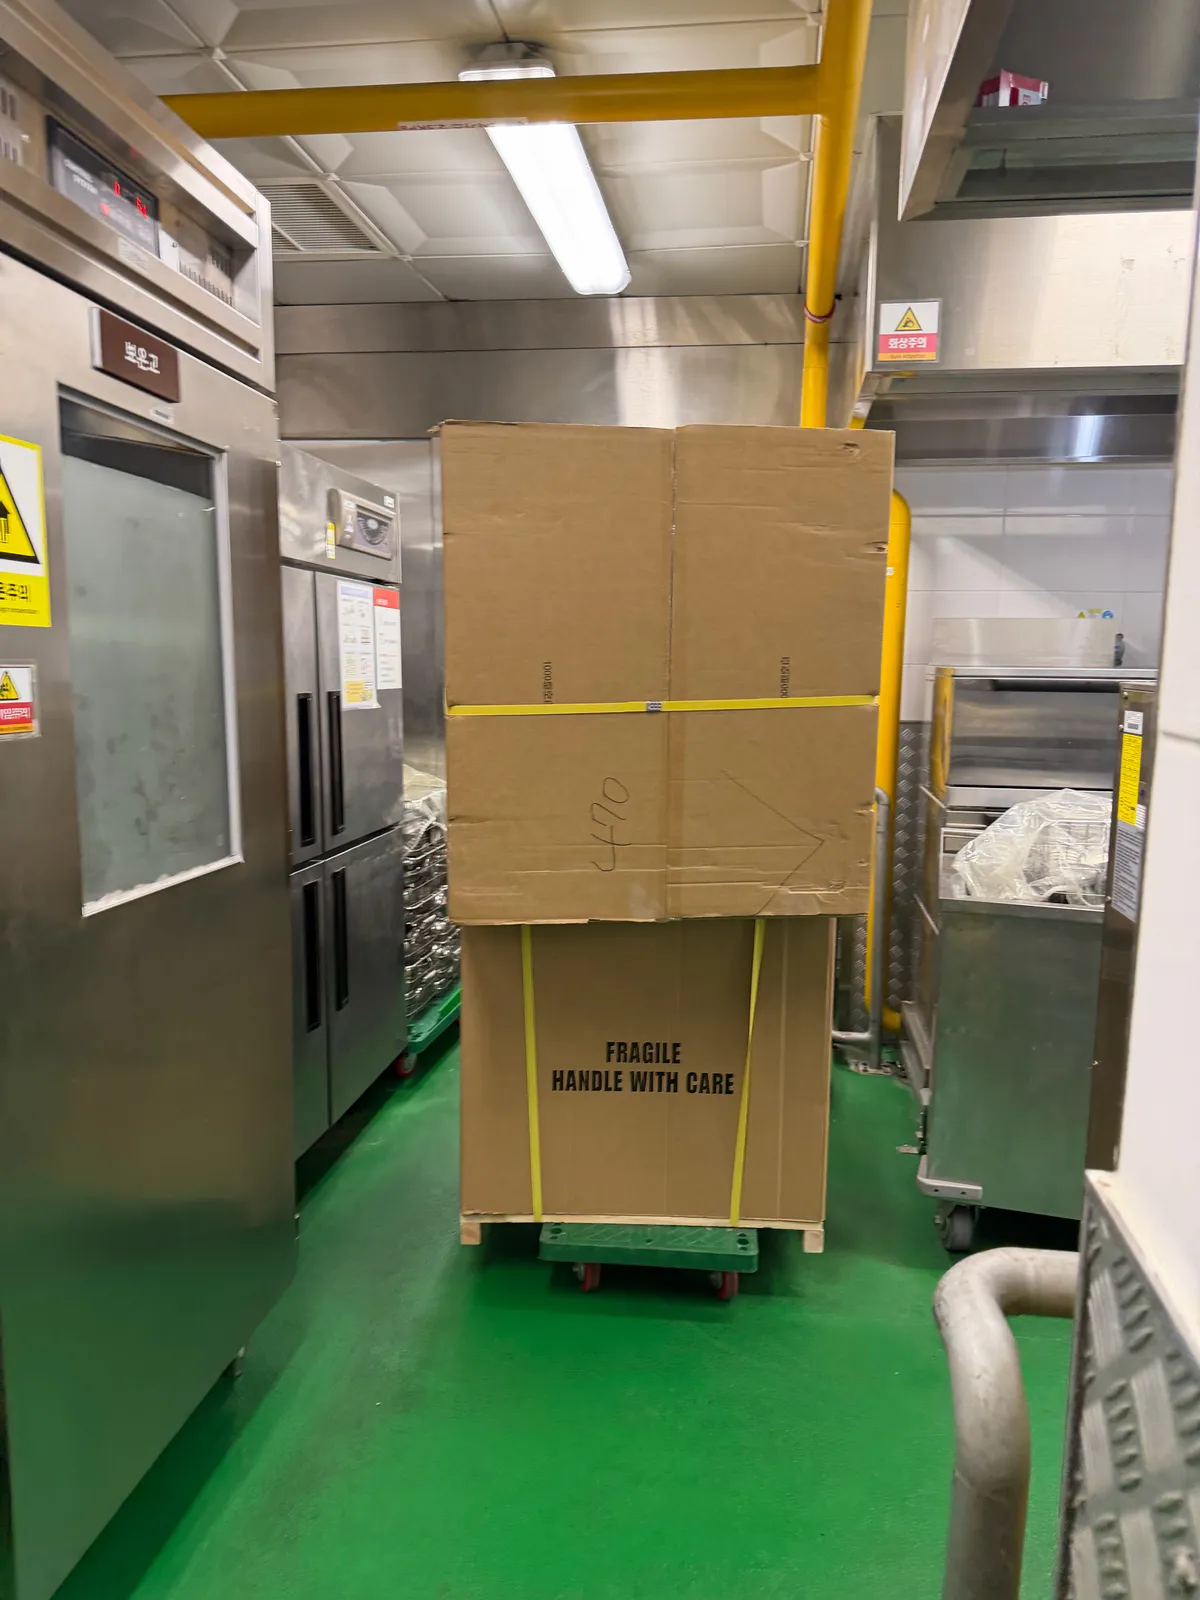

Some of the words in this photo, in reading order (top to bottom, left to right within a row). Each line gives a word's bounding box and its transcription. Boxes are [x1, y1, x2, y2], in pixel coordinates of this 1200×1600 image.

[888, 336, 927, 349] 화상주의
[606, 1042, 681, 1064] FRAGILE
[552, 1070, 622, 1092] HANDLE
[630, 1071, 679, 1093] WITH
[686, 1072, 734, 1095] CARE
